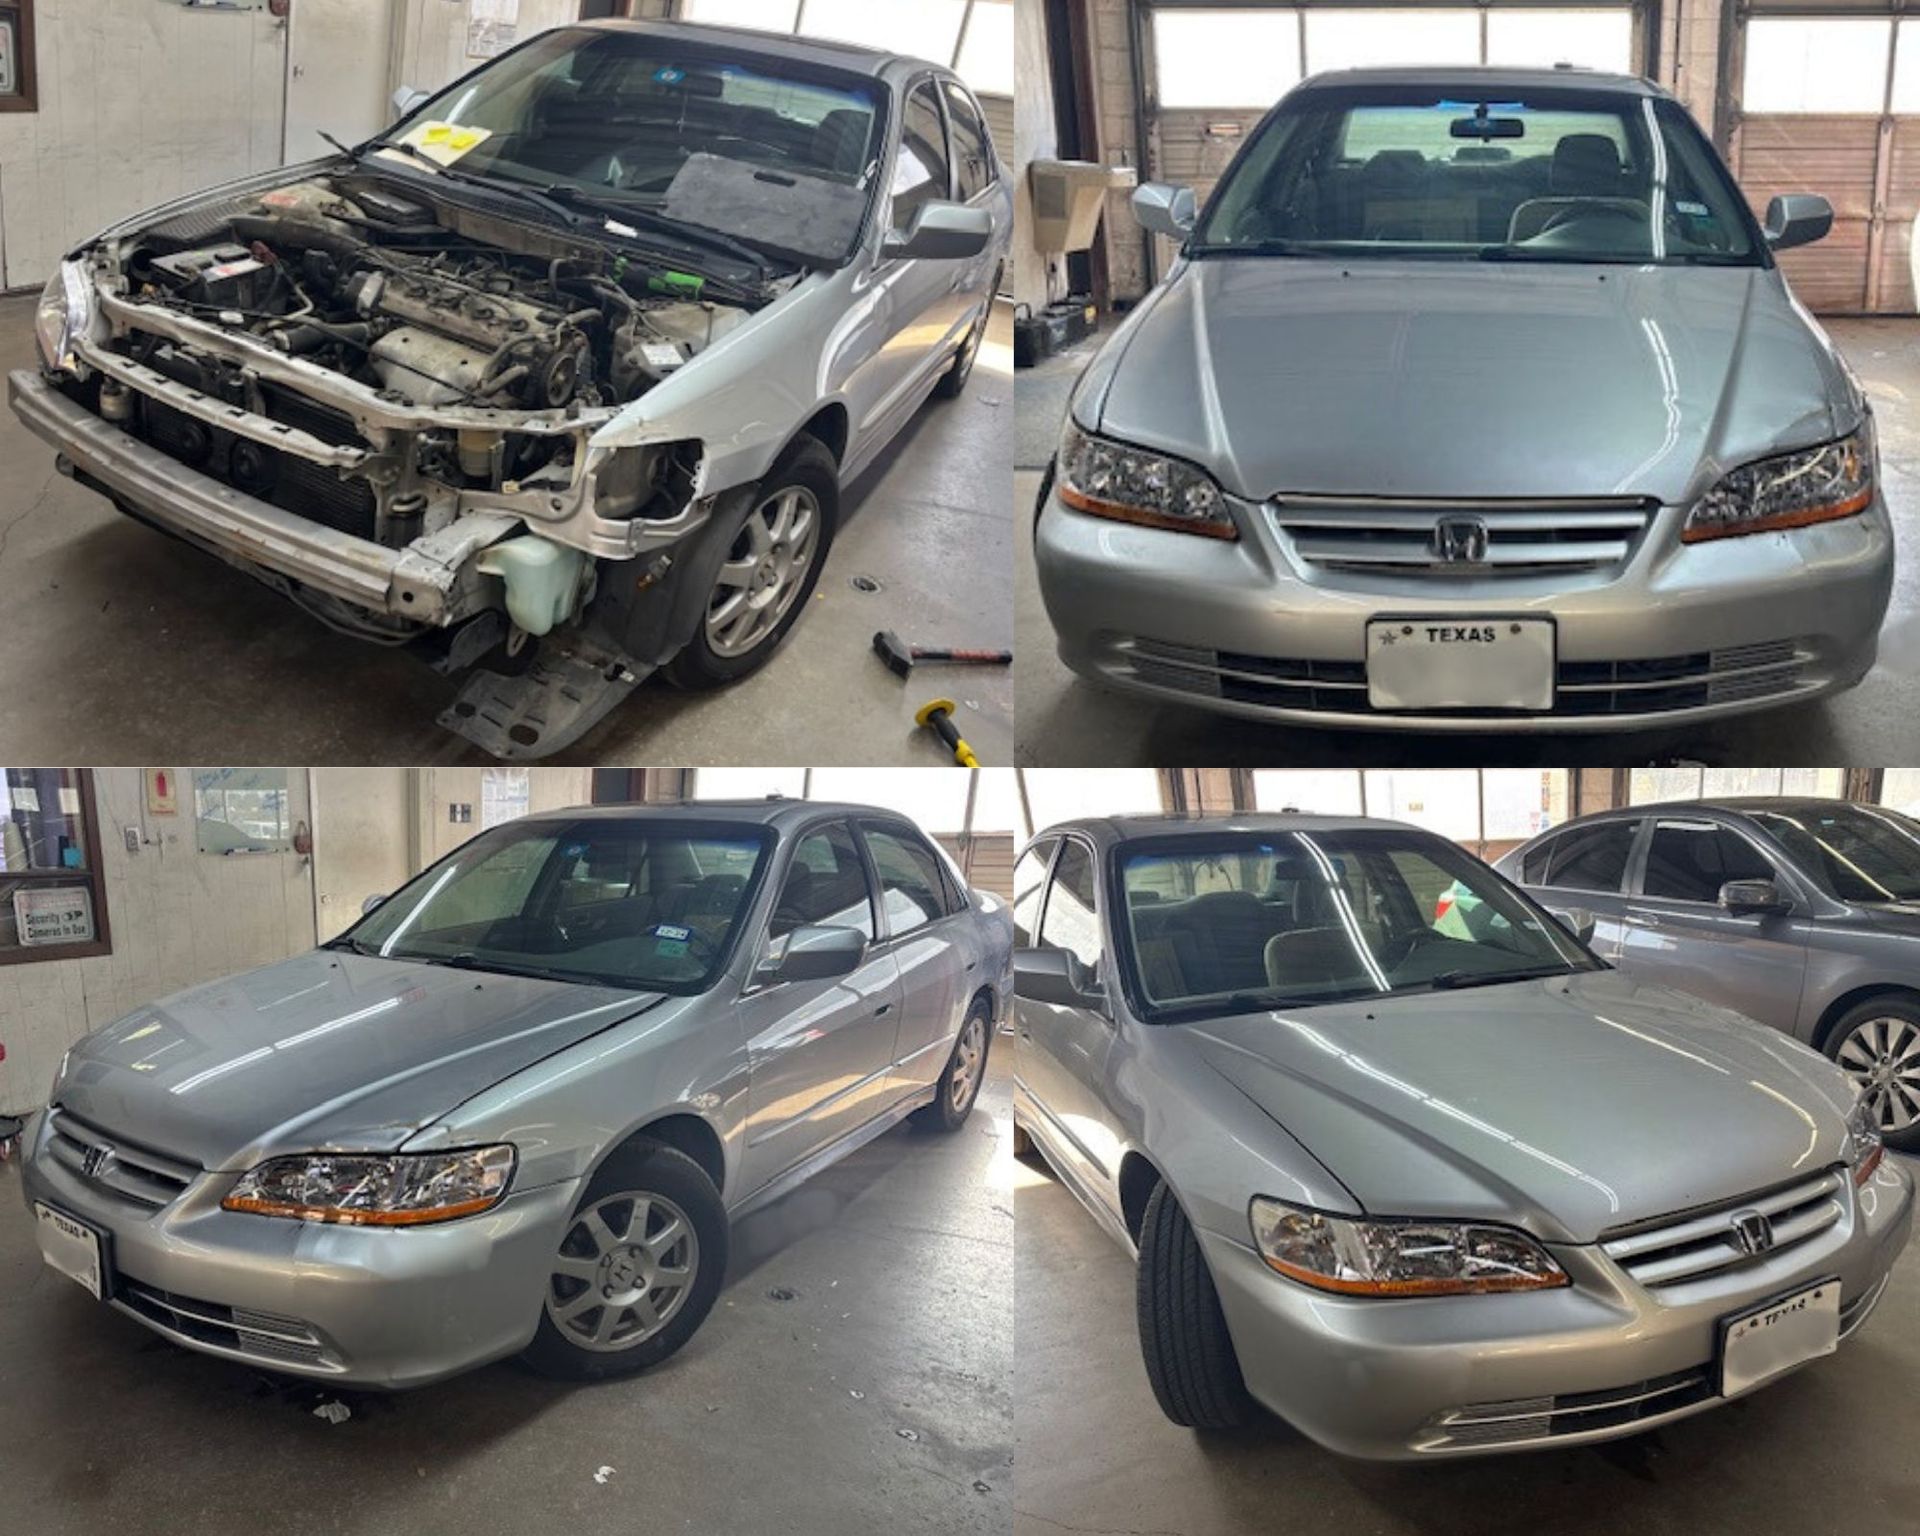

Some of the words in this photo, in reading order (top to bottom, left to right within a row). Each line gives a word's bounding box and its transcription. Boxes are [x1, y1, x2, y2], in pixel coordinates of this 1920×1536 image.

[1426, 627, 1496, 643] TEXAS
[26, 913, 60, 925] Security
[28, 927, 62, 938] Cameras
